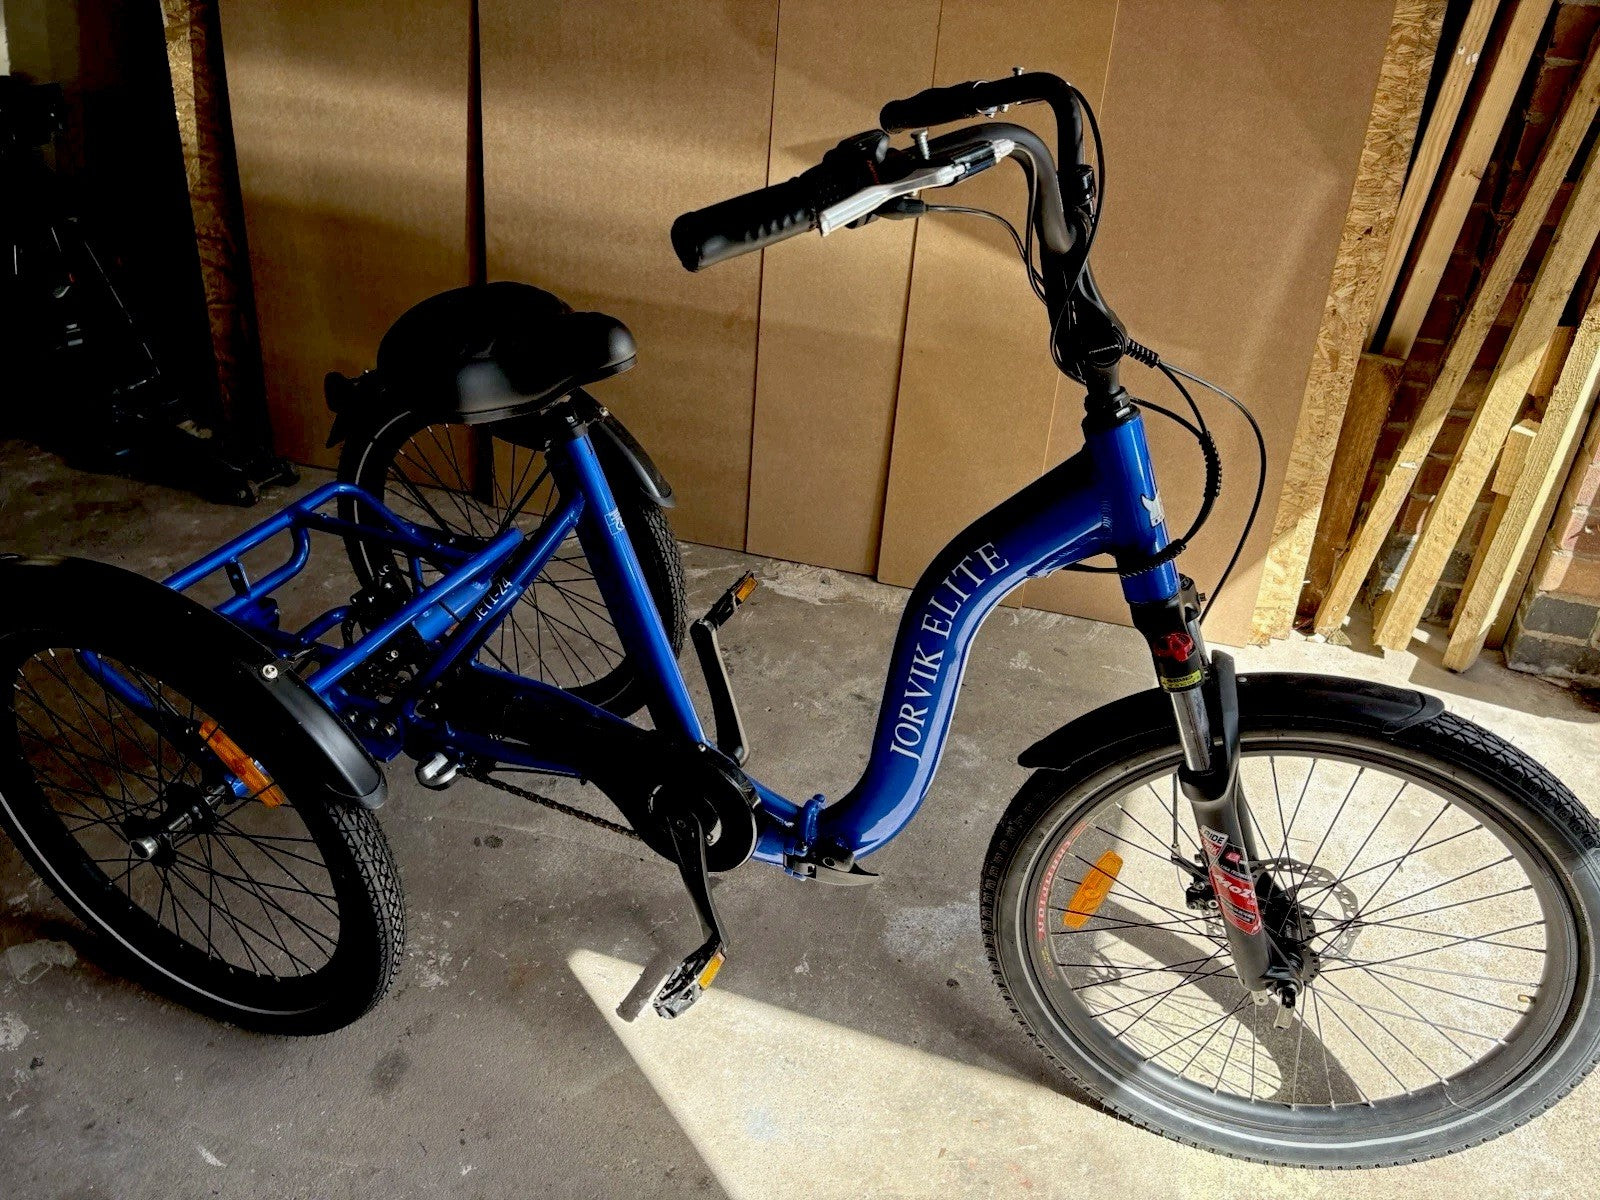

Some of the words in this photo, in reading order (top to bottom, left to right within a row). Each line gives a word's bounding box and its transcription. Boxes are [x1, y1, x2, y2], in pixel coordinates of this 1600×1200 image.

[890, 643, 944, 762] JORVIK
[921, 542, 1010, 640] ELITE
[1204, 829, 1225, 845] RIDE
